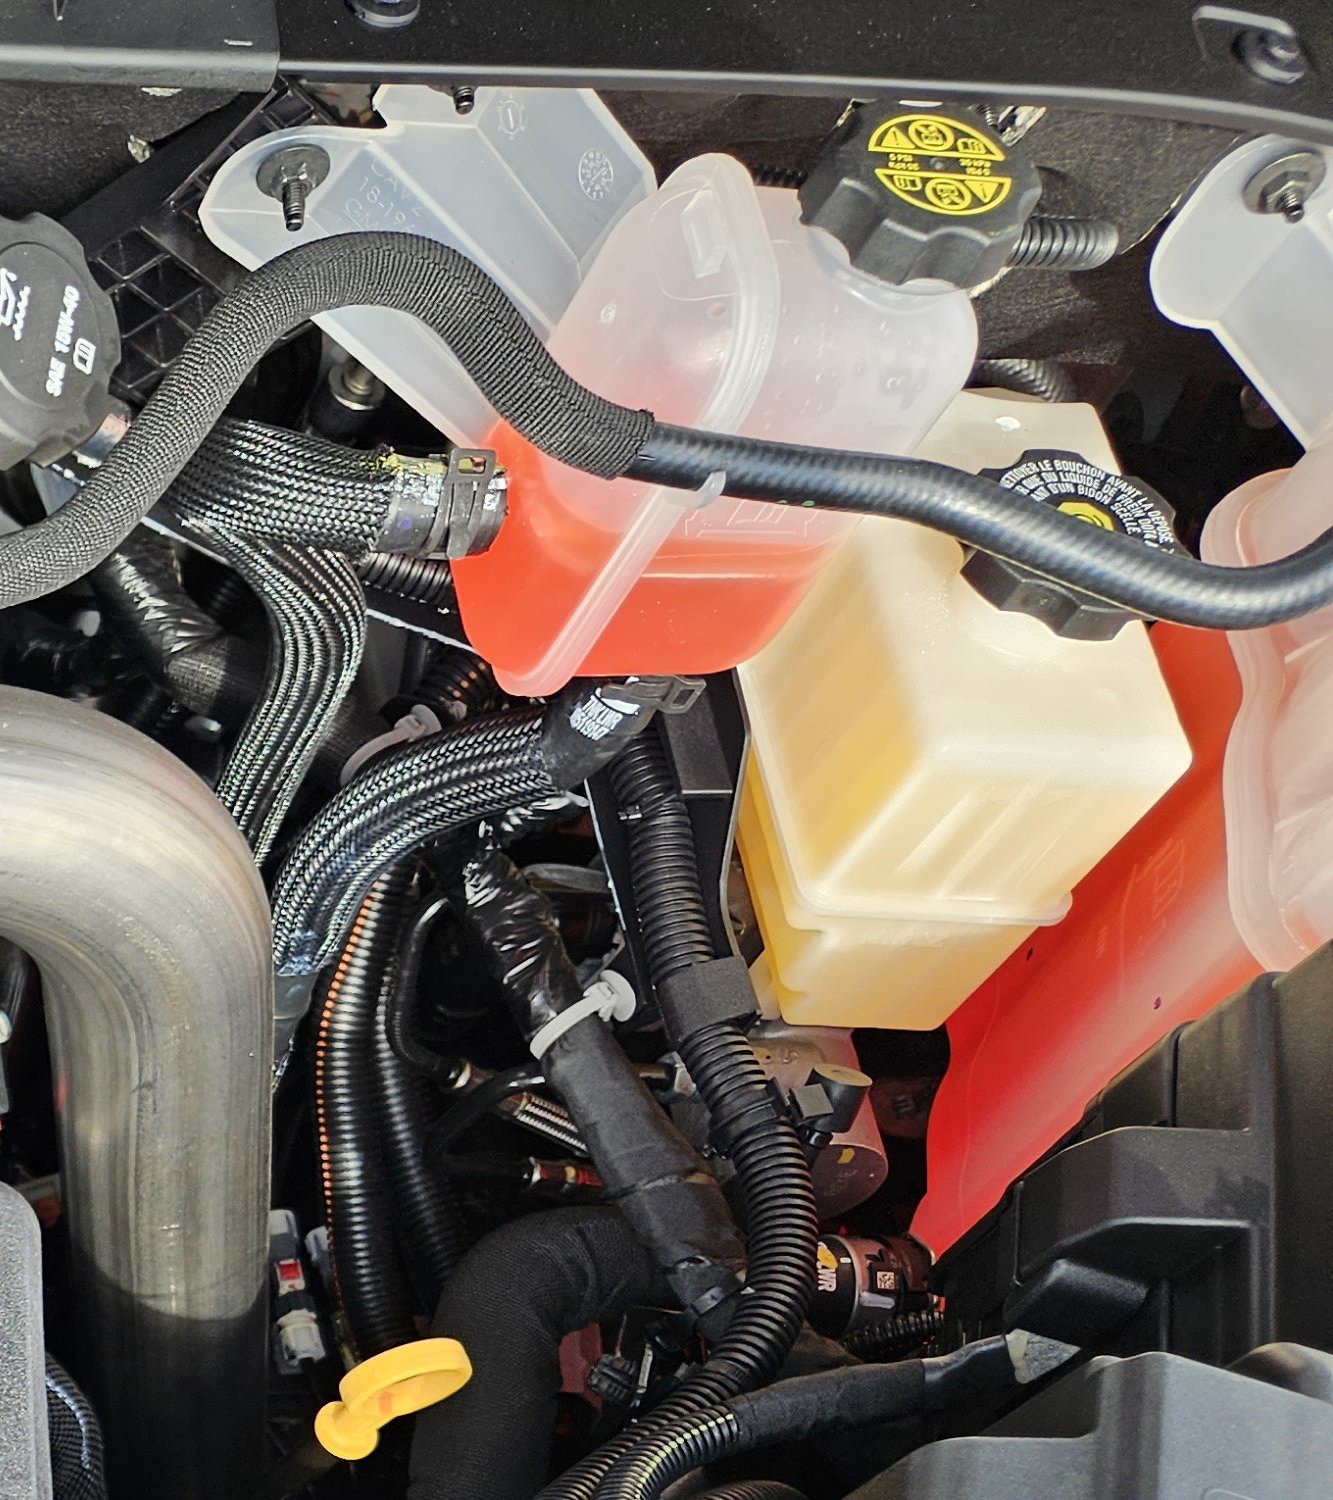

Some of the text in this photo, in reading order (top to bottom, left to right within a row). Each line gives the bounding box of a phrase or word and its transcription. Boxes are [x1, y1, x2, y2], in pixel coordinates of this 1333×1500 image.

[45, 283, 83, 398] SAE 15W-40
[1038, 459, 1051, 471] LE
[1054, 459, 1106, 480] BOUCHON
[1106, 476, 1140, 500] AVANT
[1060, 471, 1101, 489] LIQUIDE
[1103, 483, 1117, 497] DE
[1077, 485, 1112, 505] BIDON
